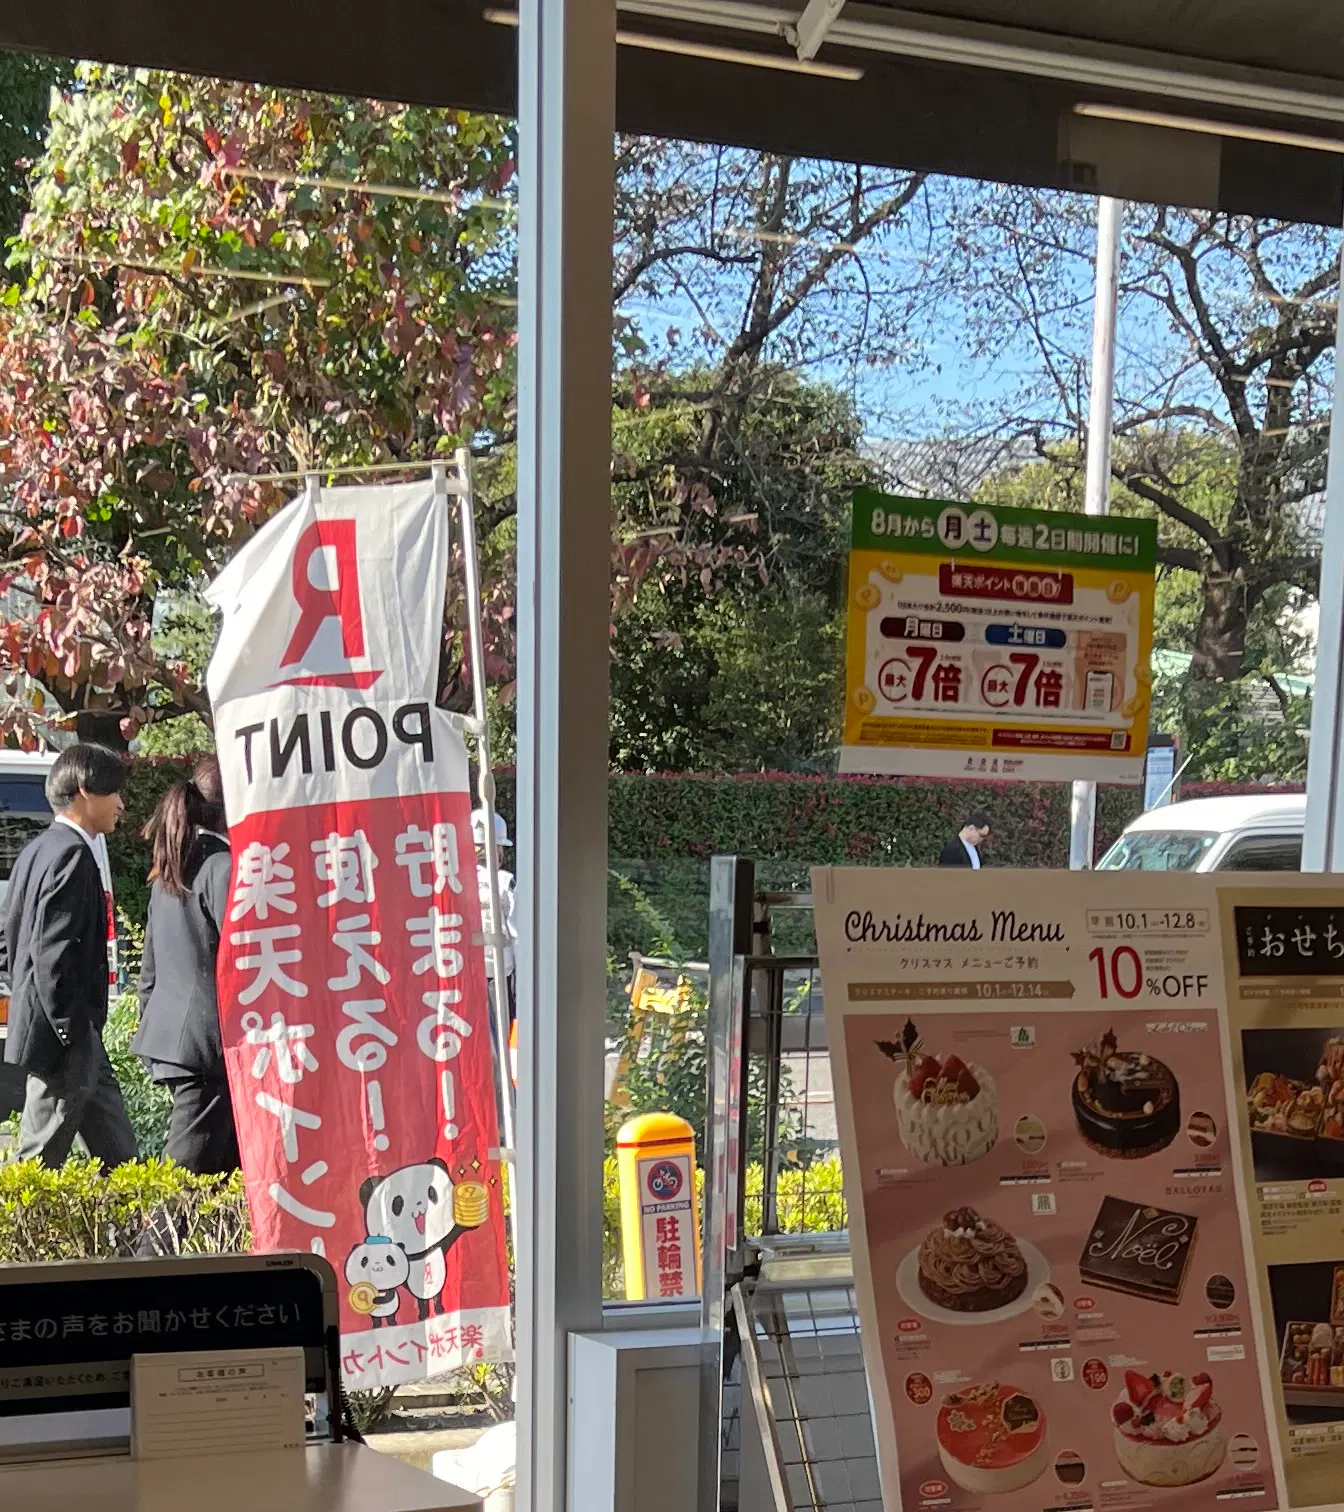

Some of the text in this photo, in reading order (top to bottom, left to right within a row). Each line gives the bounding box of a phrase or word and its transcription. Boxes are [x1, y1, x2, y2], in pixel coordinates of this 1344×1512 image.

[903, 616, 1046, 645] 月曜日 土曜日
[905, 646, 962, 703] 7倍
[1008, 652, 1063, 709] 7倍
[844, 909, 1066, 944] Christmas Menu
[900, 957, 954, 970] クリスマス
[643, 1201, 690, 1214] NO PARKING
[655, 1215, 684, 1298] 駐輪禁
